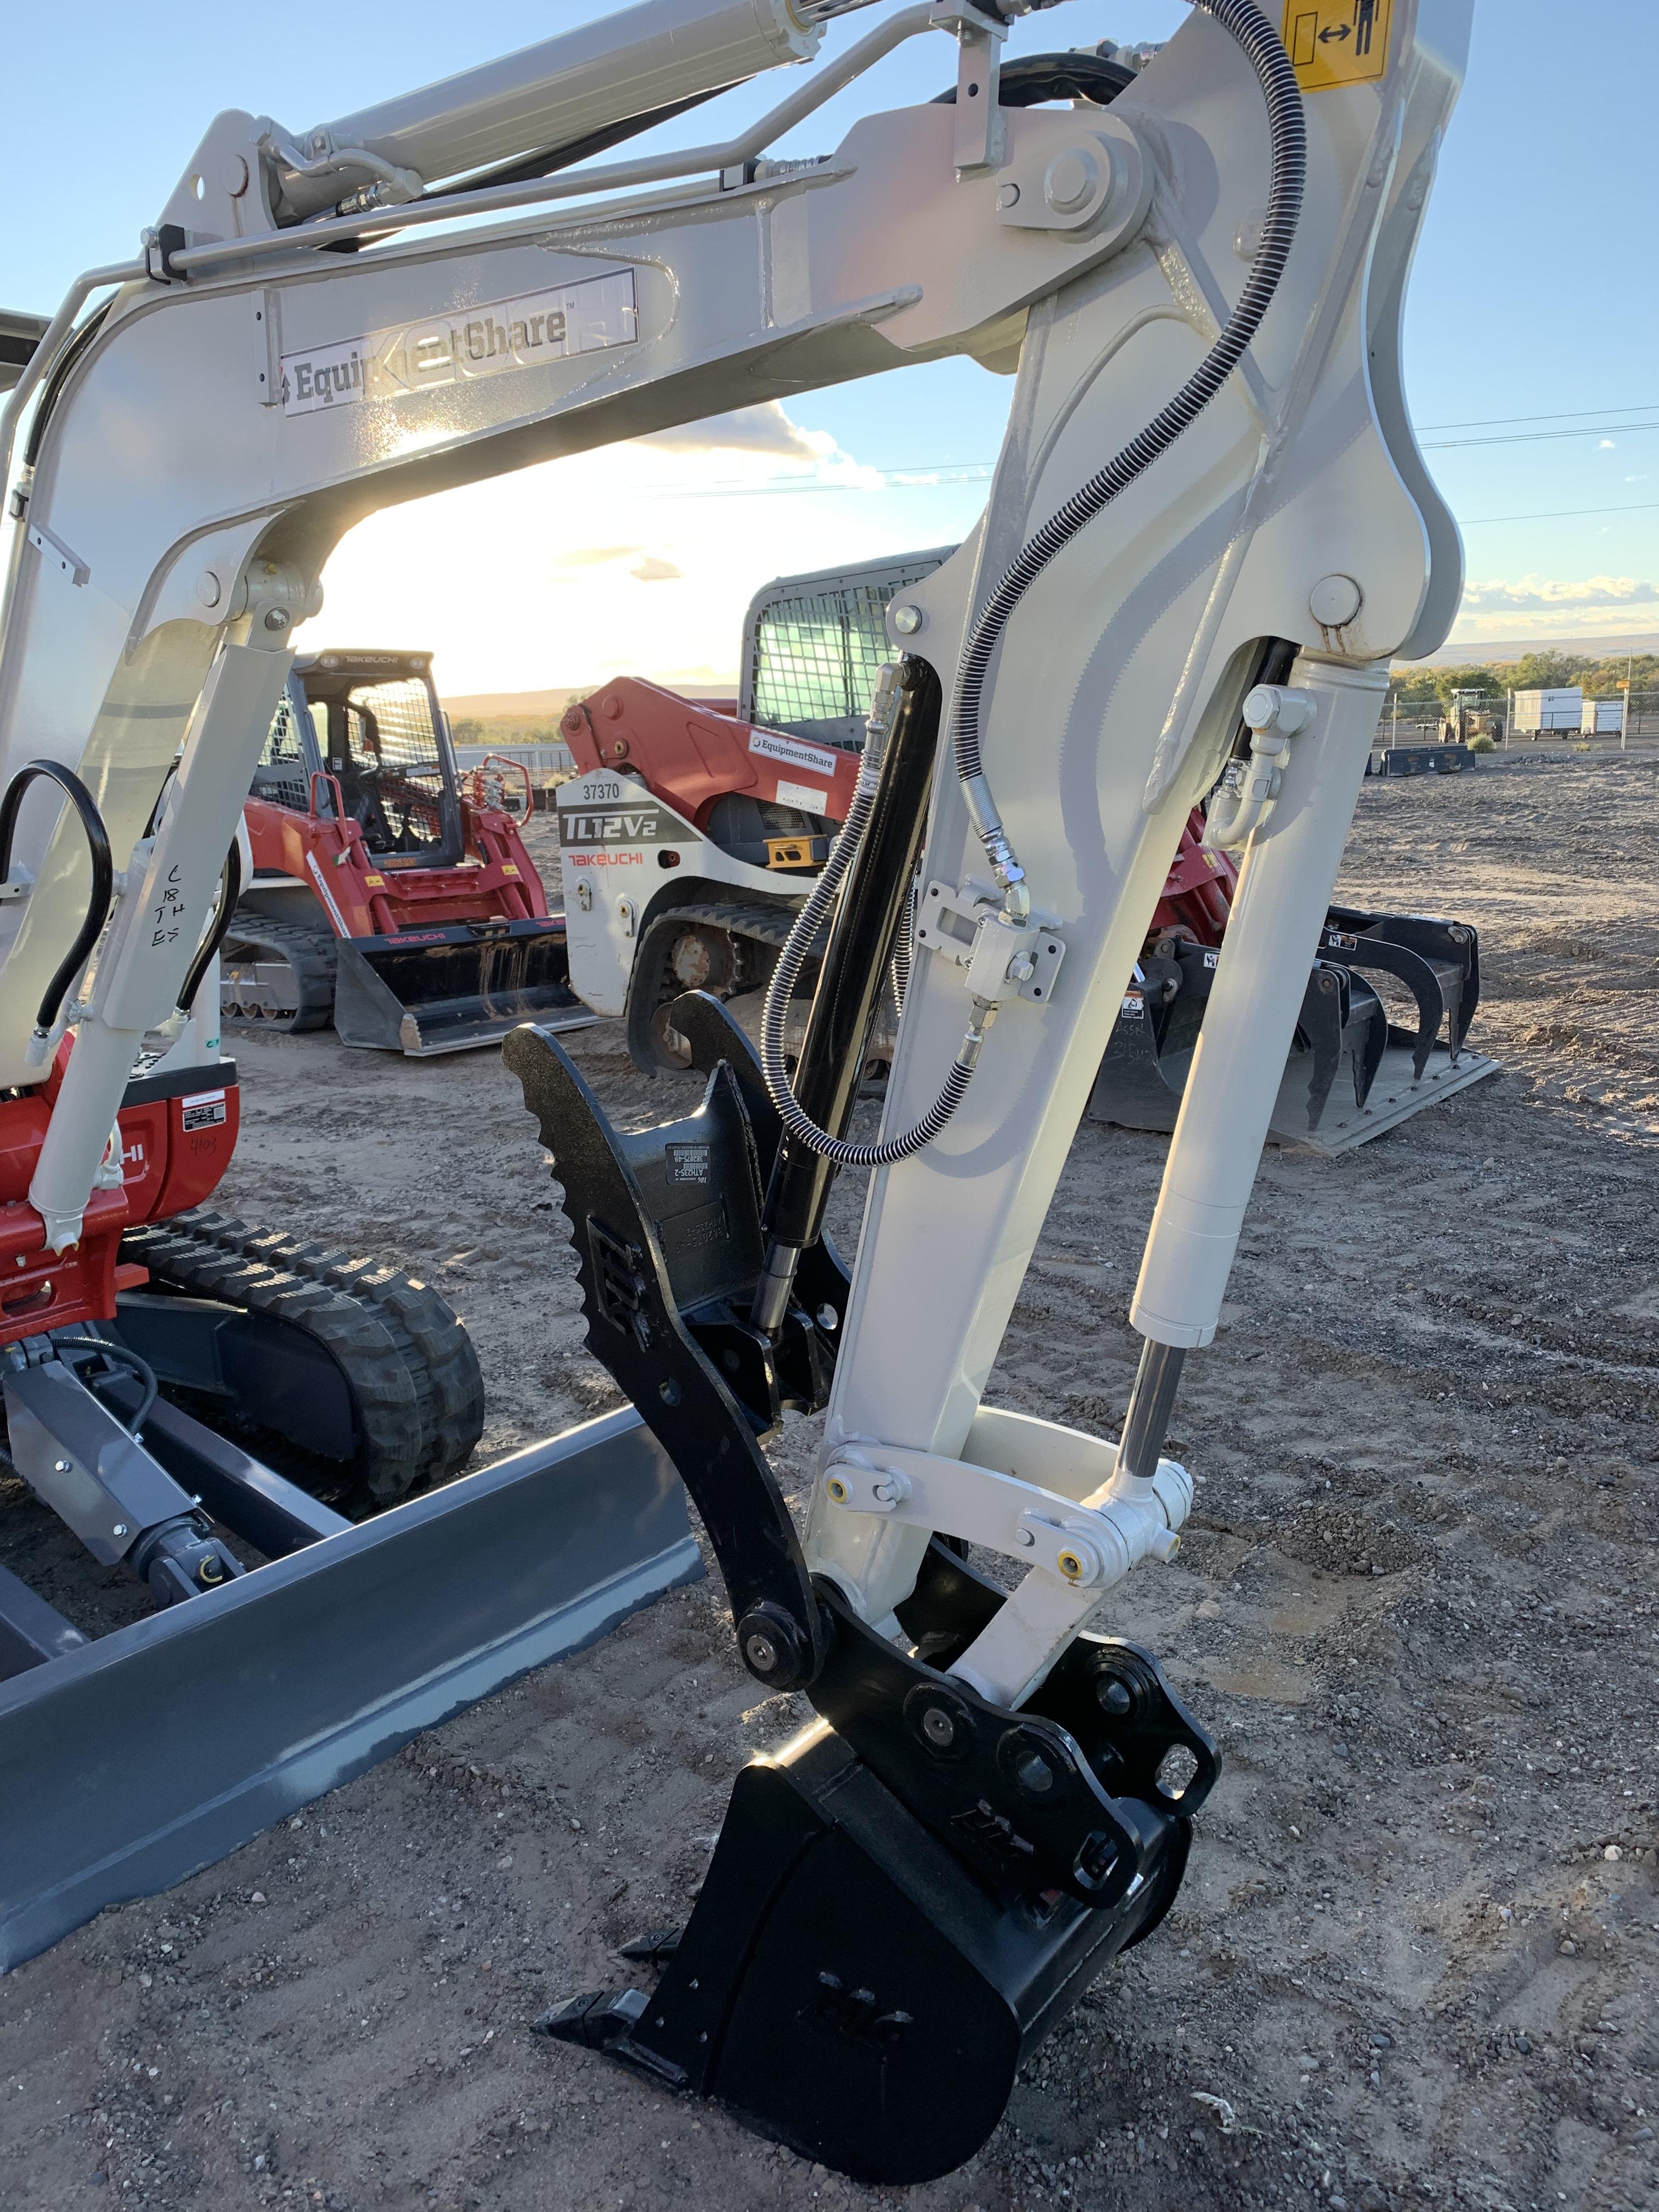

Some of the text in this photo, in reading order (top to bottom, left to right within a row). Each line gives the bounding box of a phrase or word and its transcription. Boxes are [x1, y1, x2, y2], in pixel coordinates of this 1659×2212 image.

[761, 739, 833, 768] EquipmentShare
[583, 783, 619, 800] 37370
[563, 809, 659, 840] TL12V2
[568, 853, 644, 867] TAKEUCHI
[317, 873, 350, 939] EquipmentShar
[384, 933, 446, 945] TAKEUCHI
